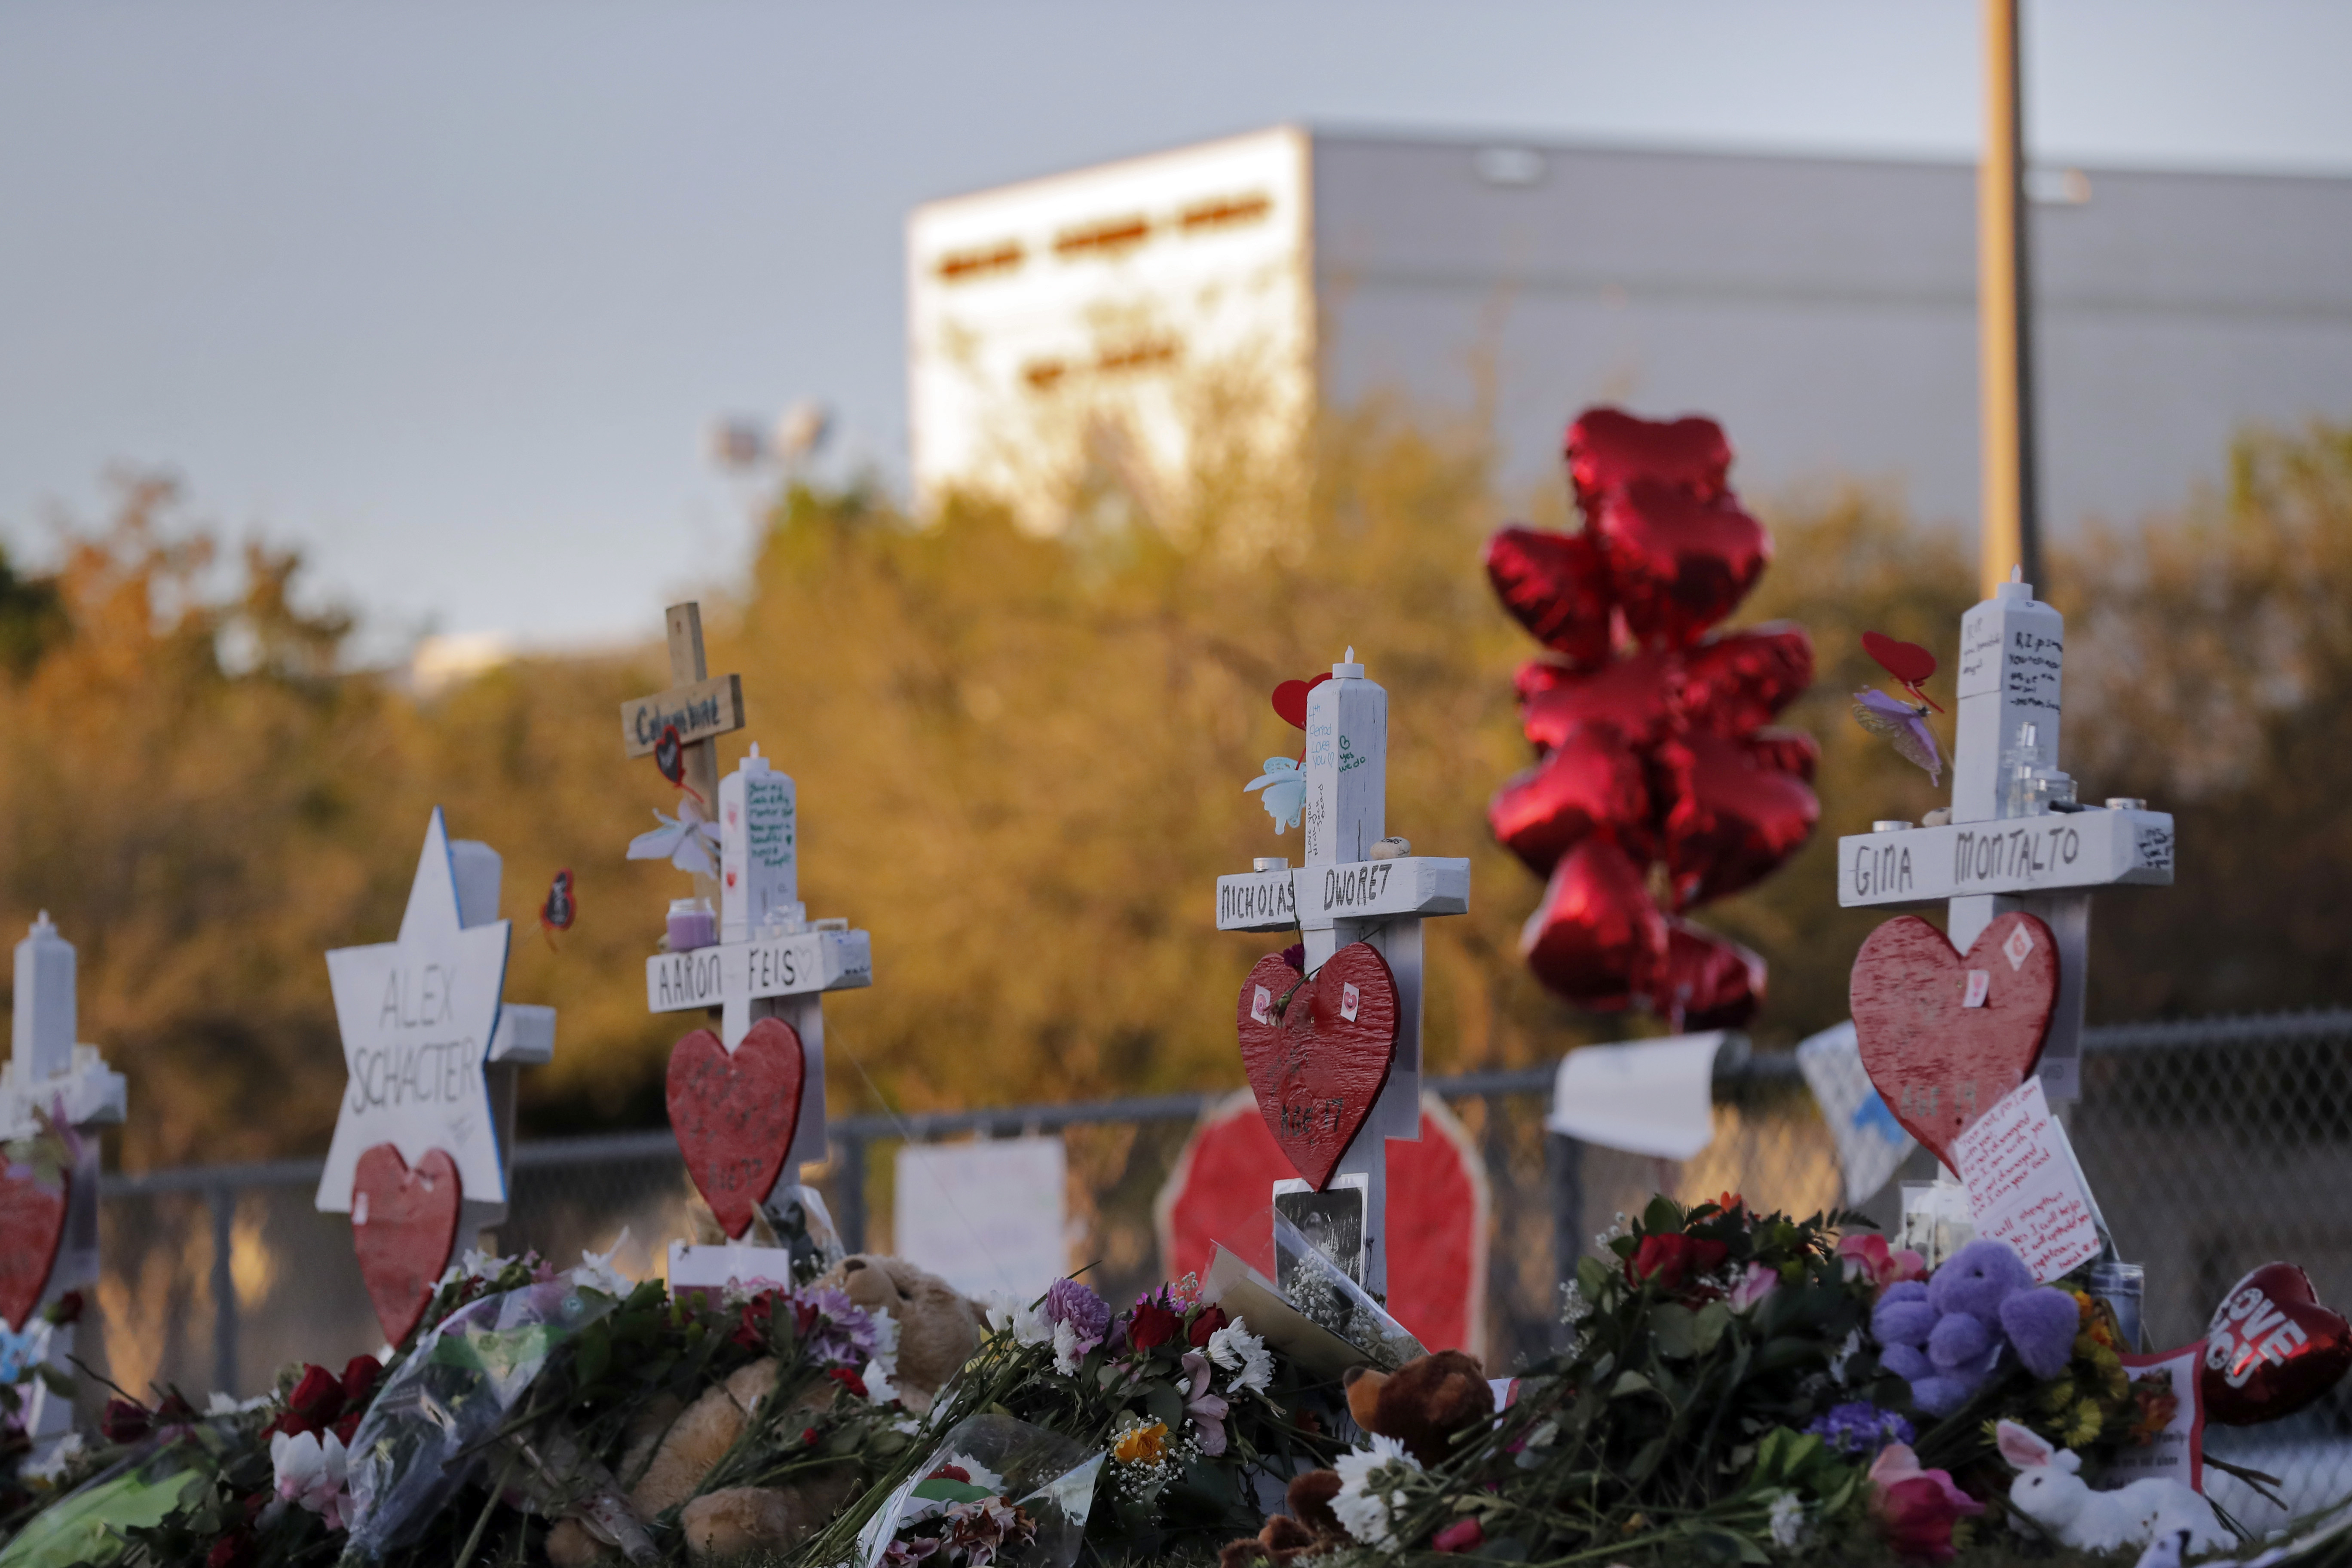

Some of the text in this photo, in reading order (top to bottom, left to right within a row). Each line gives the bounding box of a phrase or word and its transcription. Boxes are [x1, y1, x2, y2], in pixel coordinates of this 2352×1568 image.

[1221, 864, 1392, 924] NICHOLAS DWORET
[1854, 844, 1914, 896] GINA
[1954, 827, 2079, 885] MONTALTO
[378, 963, 457, 1030] ALEX
[658, 948, 796, 1006] AARON FEIS
[351, 1035, 478, 1116] SCHACTER
